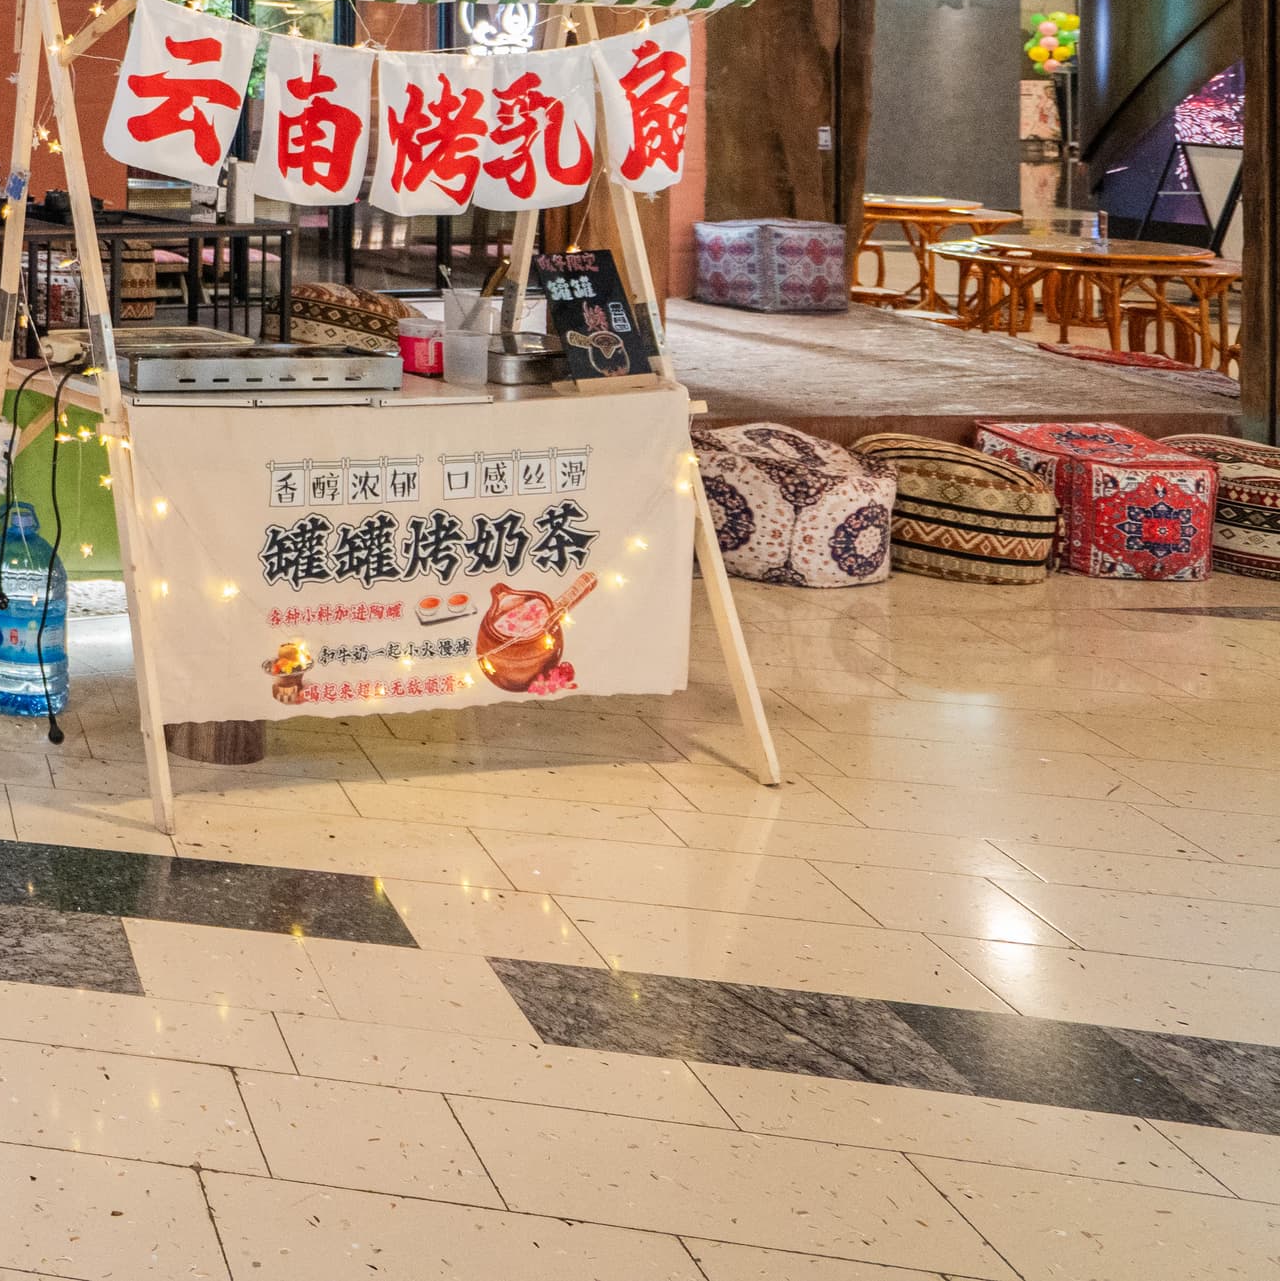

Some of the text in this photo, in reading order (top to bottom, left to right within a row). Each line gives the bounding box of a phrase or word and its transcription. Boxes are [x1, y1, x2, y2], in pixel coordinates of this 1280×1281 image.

[274, 458, 587, 504] 香醇浓郁 口感丝滑
[262, 500, 598, 589] 罐罐烤奶茶
[267, 599, 405, 627] 各种小料加进陶罐
[318, 638, 471, 666] 和牛奶一起小火慢烤
